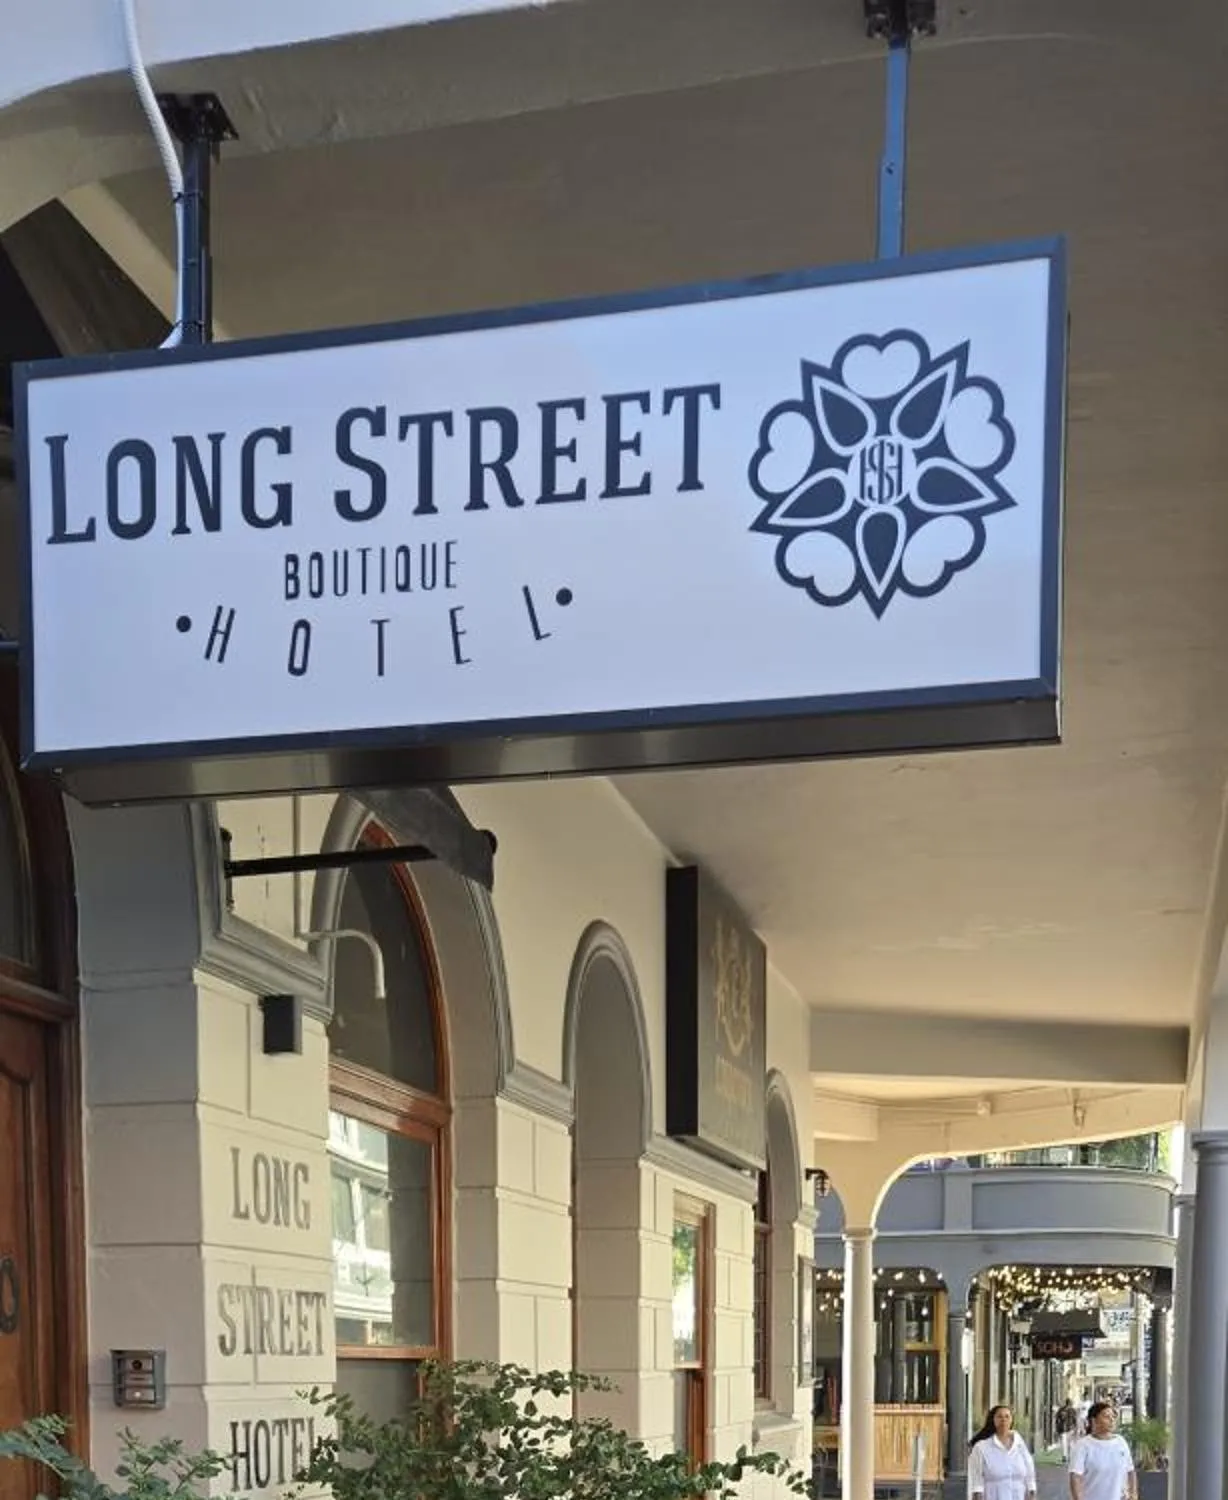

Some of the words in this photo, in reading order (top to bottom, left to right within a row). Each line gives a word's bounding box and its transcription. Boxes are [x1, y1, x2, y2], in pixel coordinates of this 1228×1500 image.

[44, 425, 294, 545] LONG
[334, 383, 721, 523] STREET
[284, 541, 458, 600] BOUTIQUE
[204, 585, 552, 677] HOTEL
[230, 1146, 311, 1230] LONG
[217, 1283, 327, 1357] STREET
